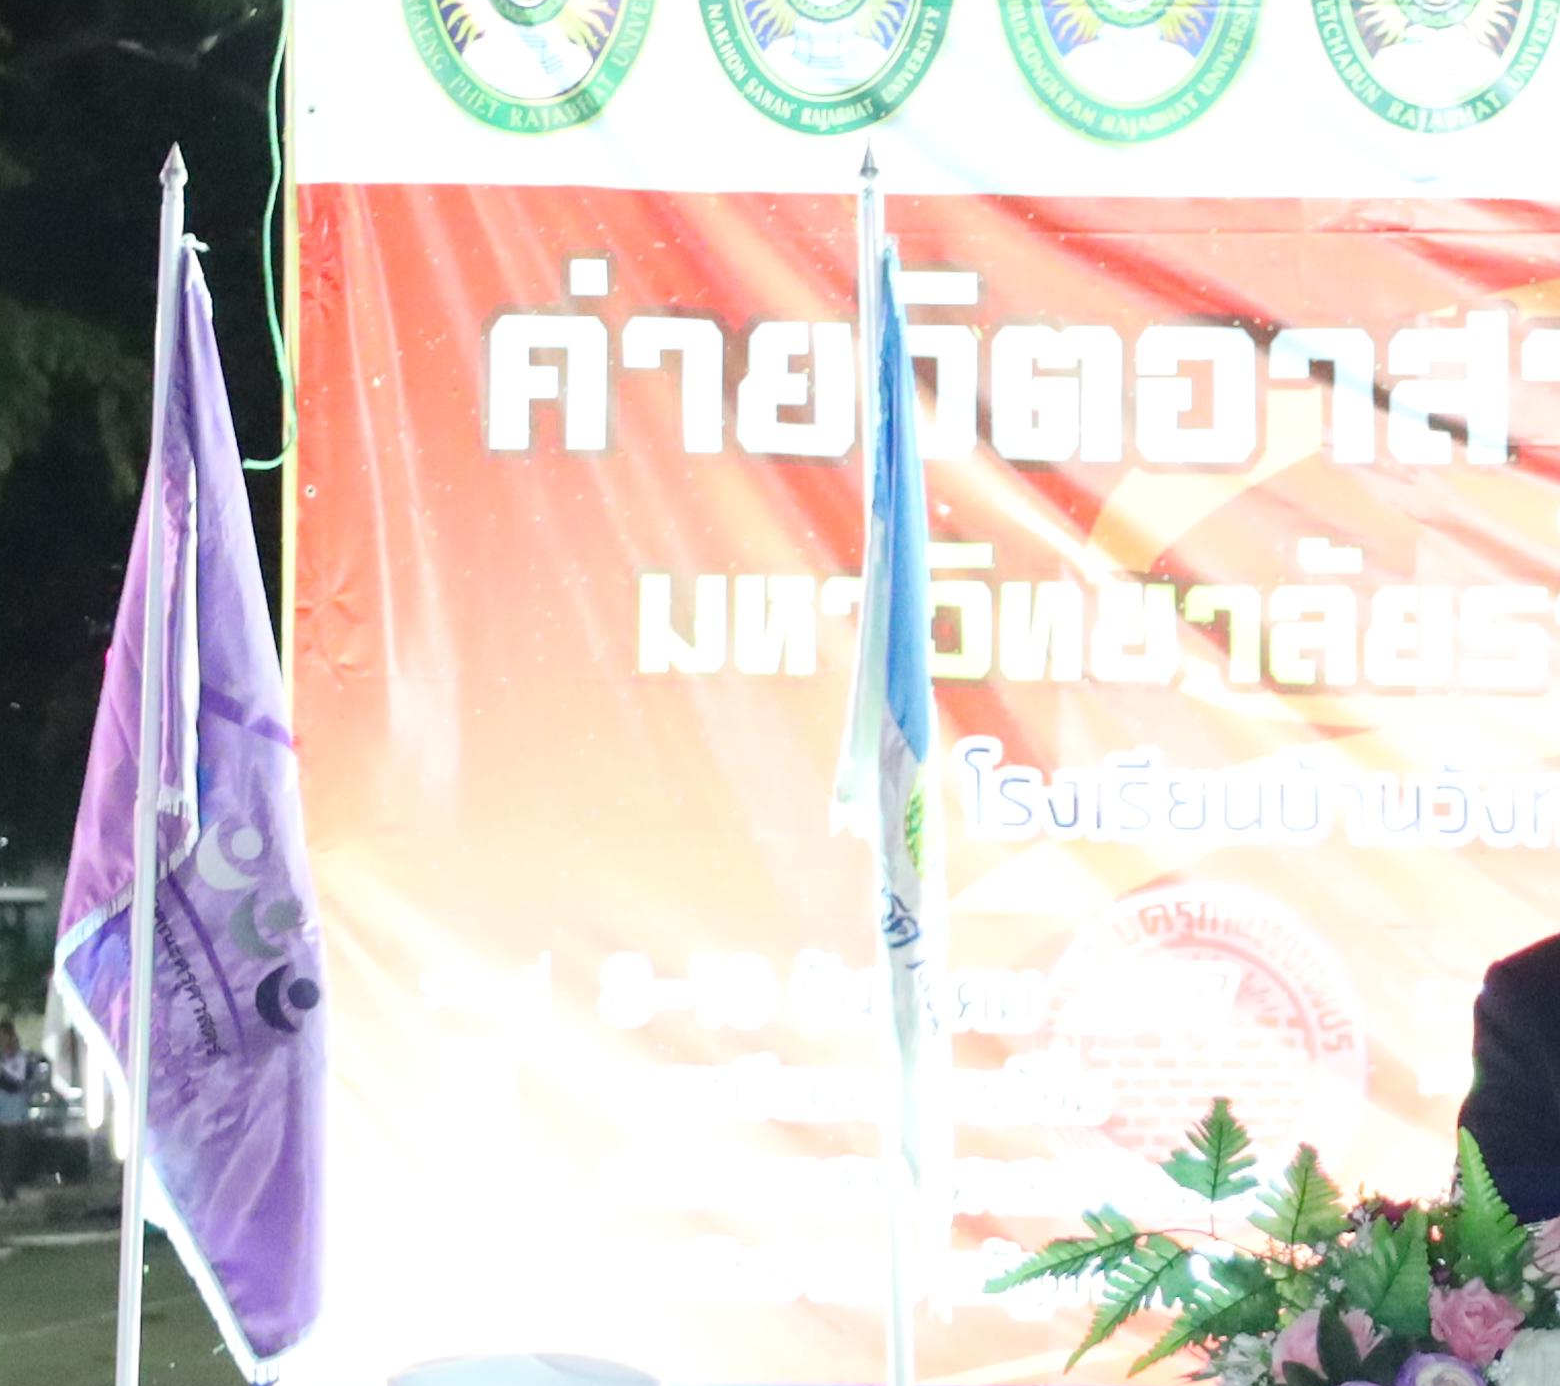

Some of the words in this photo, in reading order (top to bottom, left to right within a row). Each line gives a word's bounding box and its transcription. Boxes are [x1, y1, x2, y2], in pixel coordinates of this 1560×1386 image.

[739, 70, 797, 127] SAWAN
[795, 92, 879, 131] RAJABHAT
[873, 2, 950, 109] UNIVERSITY
[443, 67, 503, 124] PHET
[504, 63, 618, 134] RAJABHAT
[1094, 87, 1207, 143] RAJABHAT
[1382, 82, 1506, 135] RAJABHAT
